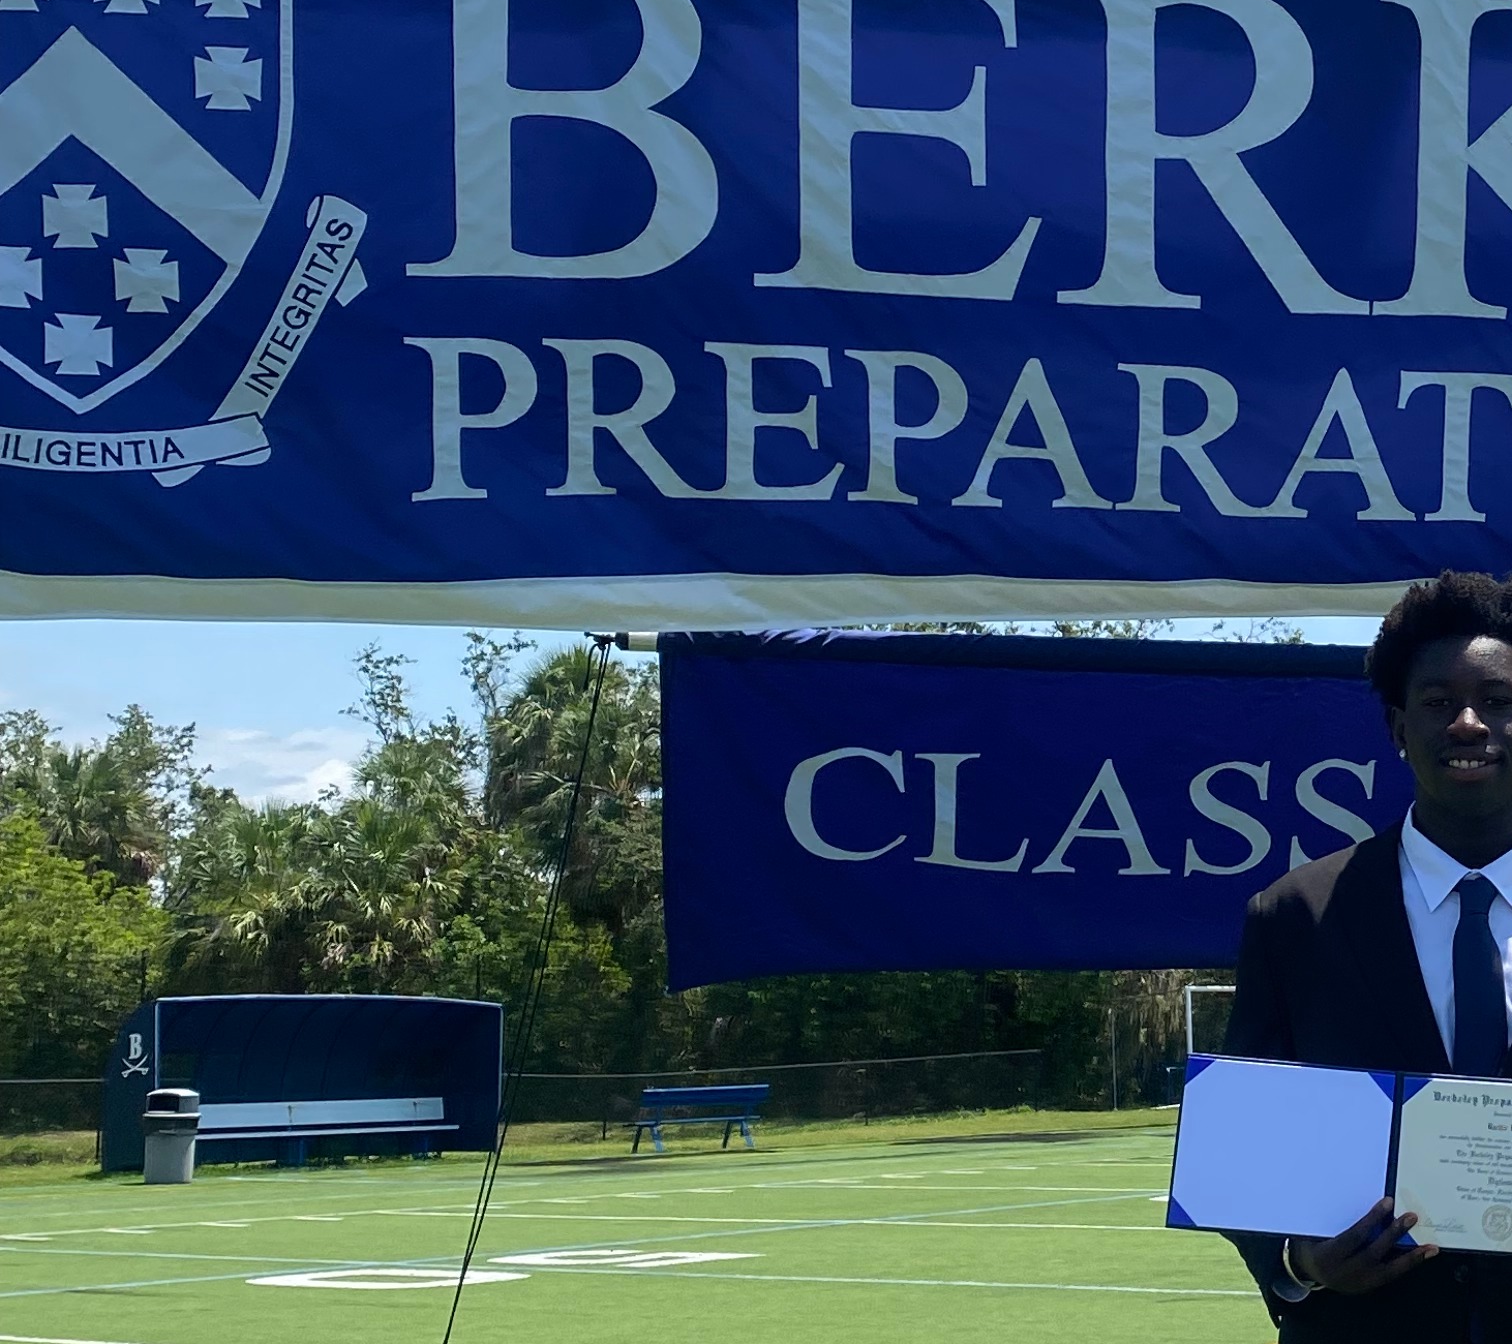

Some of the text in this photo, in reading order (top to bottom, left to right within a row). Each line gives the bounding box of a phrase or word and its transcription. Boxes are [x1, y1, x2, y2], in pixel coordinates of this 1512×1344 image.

[245, 217, 354, 398] INTEGRITAS
[1, 433, 185, 467] ILIGENTIA
[785, 748, 1376, 878] CLASS
[129, 1033, 142, 1059] B
